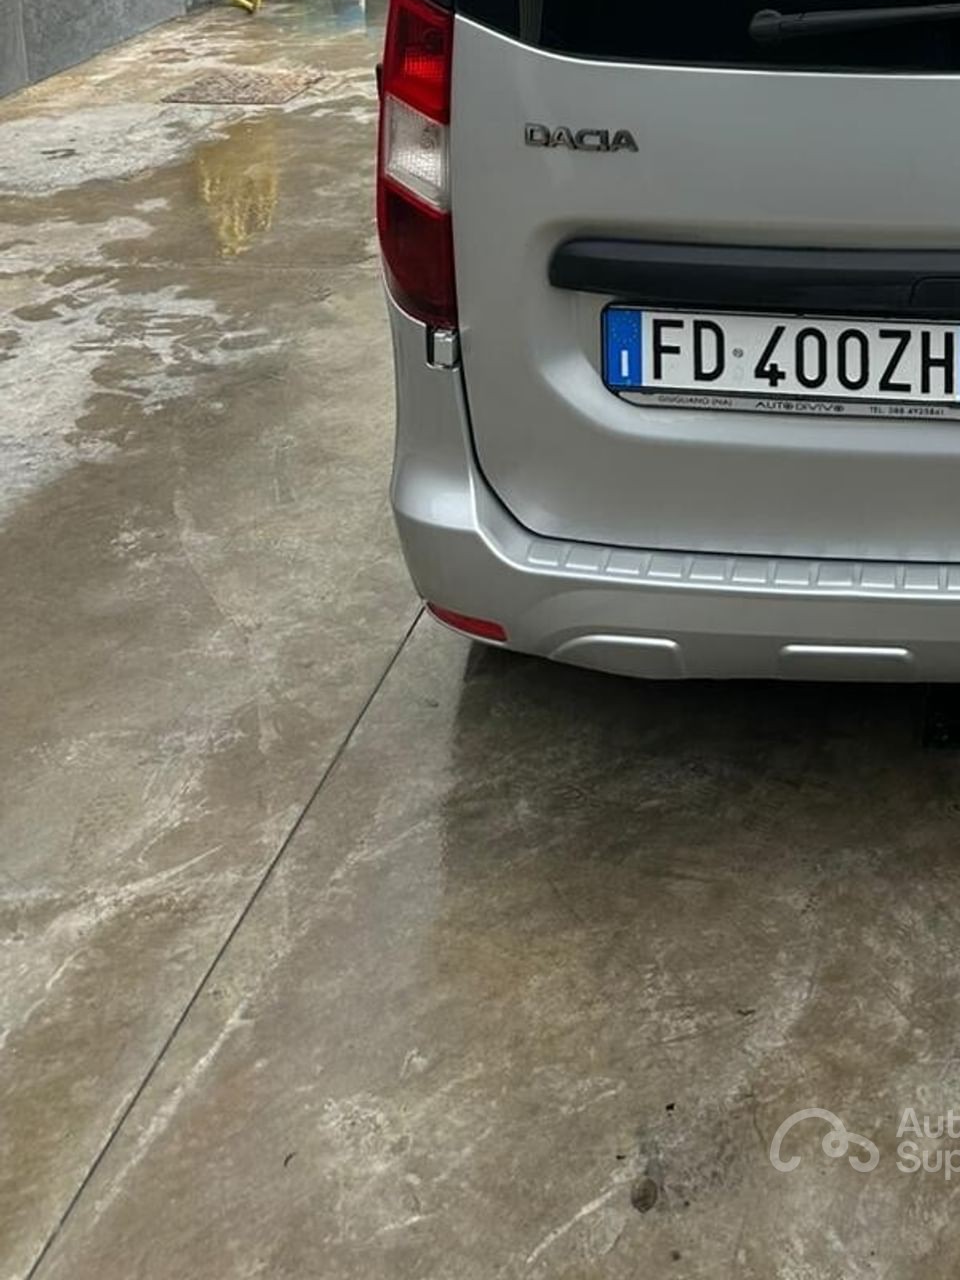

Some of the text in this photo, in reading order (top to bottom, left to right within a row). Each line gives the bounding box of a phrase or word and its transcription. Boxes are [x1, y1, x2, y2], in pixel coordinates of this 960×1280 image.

[525, 122, 639, 152] DACIA
[652, 319, 954, 394] FD 400ZH
